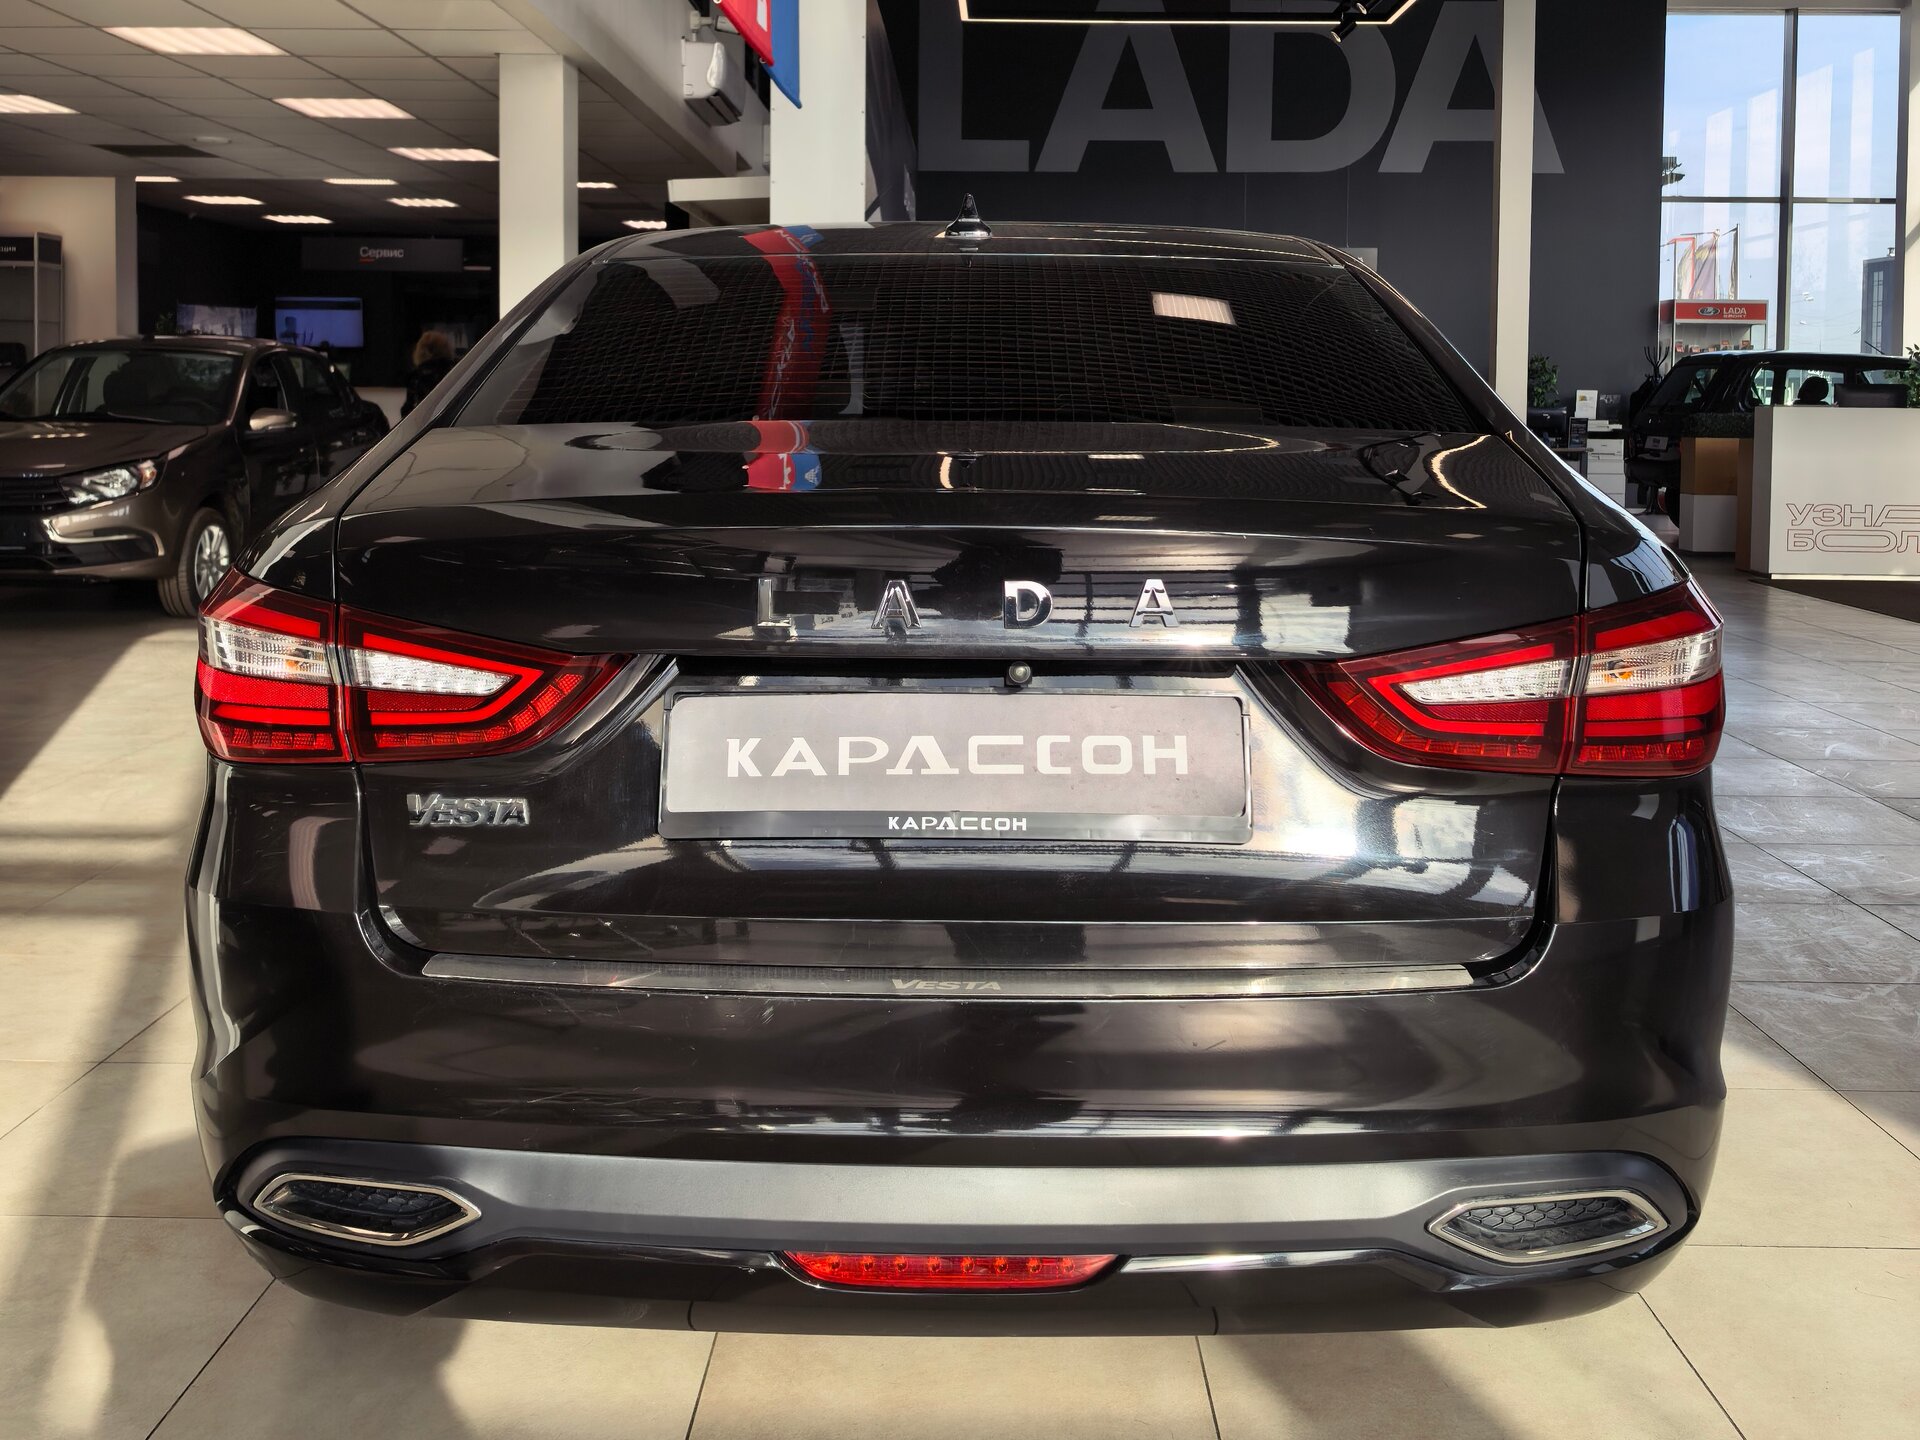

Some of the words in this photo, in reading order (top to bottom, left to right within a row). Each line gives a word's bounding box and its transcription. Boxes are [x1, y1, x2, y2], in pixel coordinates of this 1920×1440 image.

[917, 0, 1565, 173] LADA
[359, 246, 404, 259] Сервис
[1722, 307, 1747, 315] LADA
[757, 577, 1180, 629] LADA
[406, 793, 530, 827] VESTA
[891, 978, 1002, 991] VESTA
